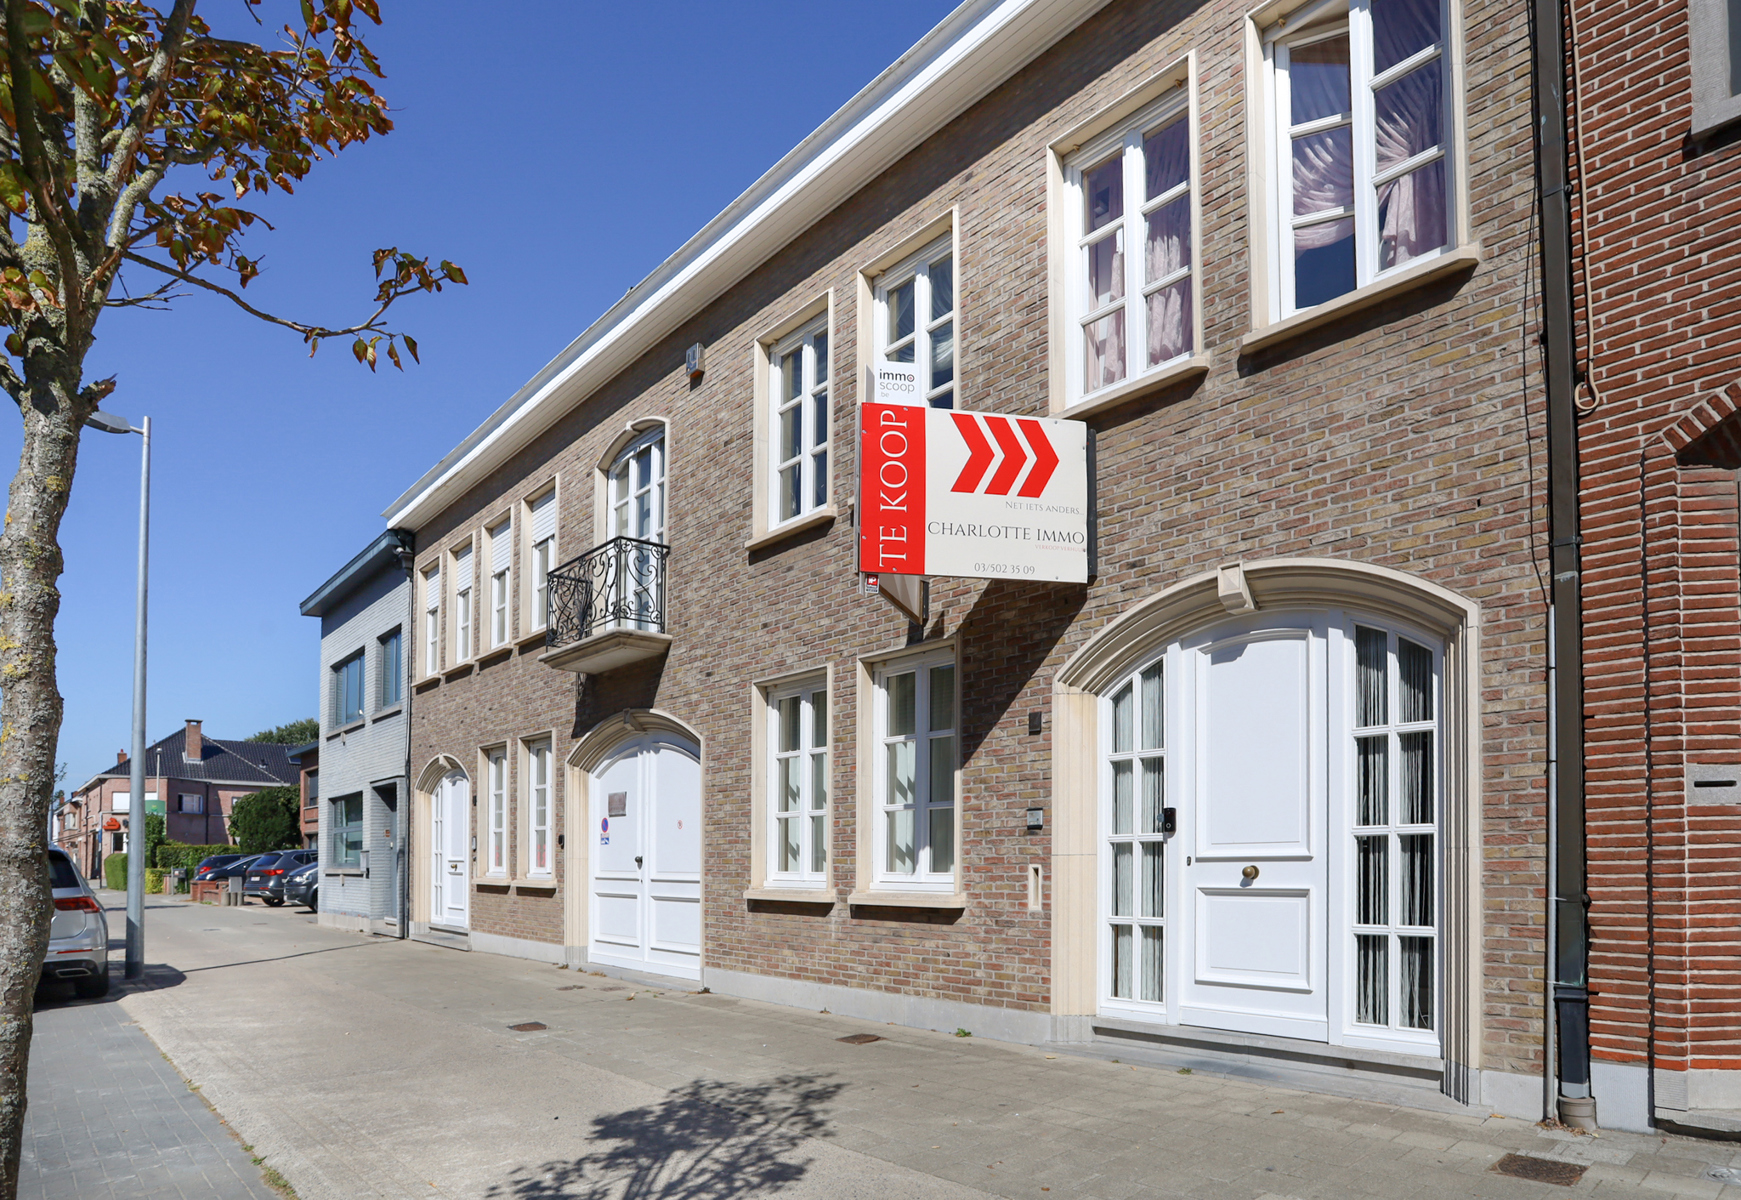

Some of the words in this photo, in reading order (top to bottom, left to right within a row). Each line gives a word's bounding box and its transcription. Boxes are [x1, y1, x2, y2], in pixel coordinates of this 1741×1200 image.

[880, 368, 915, 382] immo
[880, 381, 915, 394] scoop
[879, 409, 908, 513] KOOP
[1005, 501, 1024, 510] NET
[1026, 503, 1043, 511] IETS
[927, 521, 1031, 541] CHARLOTTE
[1037, 528, 1085, 544] IMMO
[879, 525, 908, 567] TE
[974, 562, 1008, 574] 03/502
[1011, 564, 1021, 575] 35
[1023, 565, 1036, 575] 09
